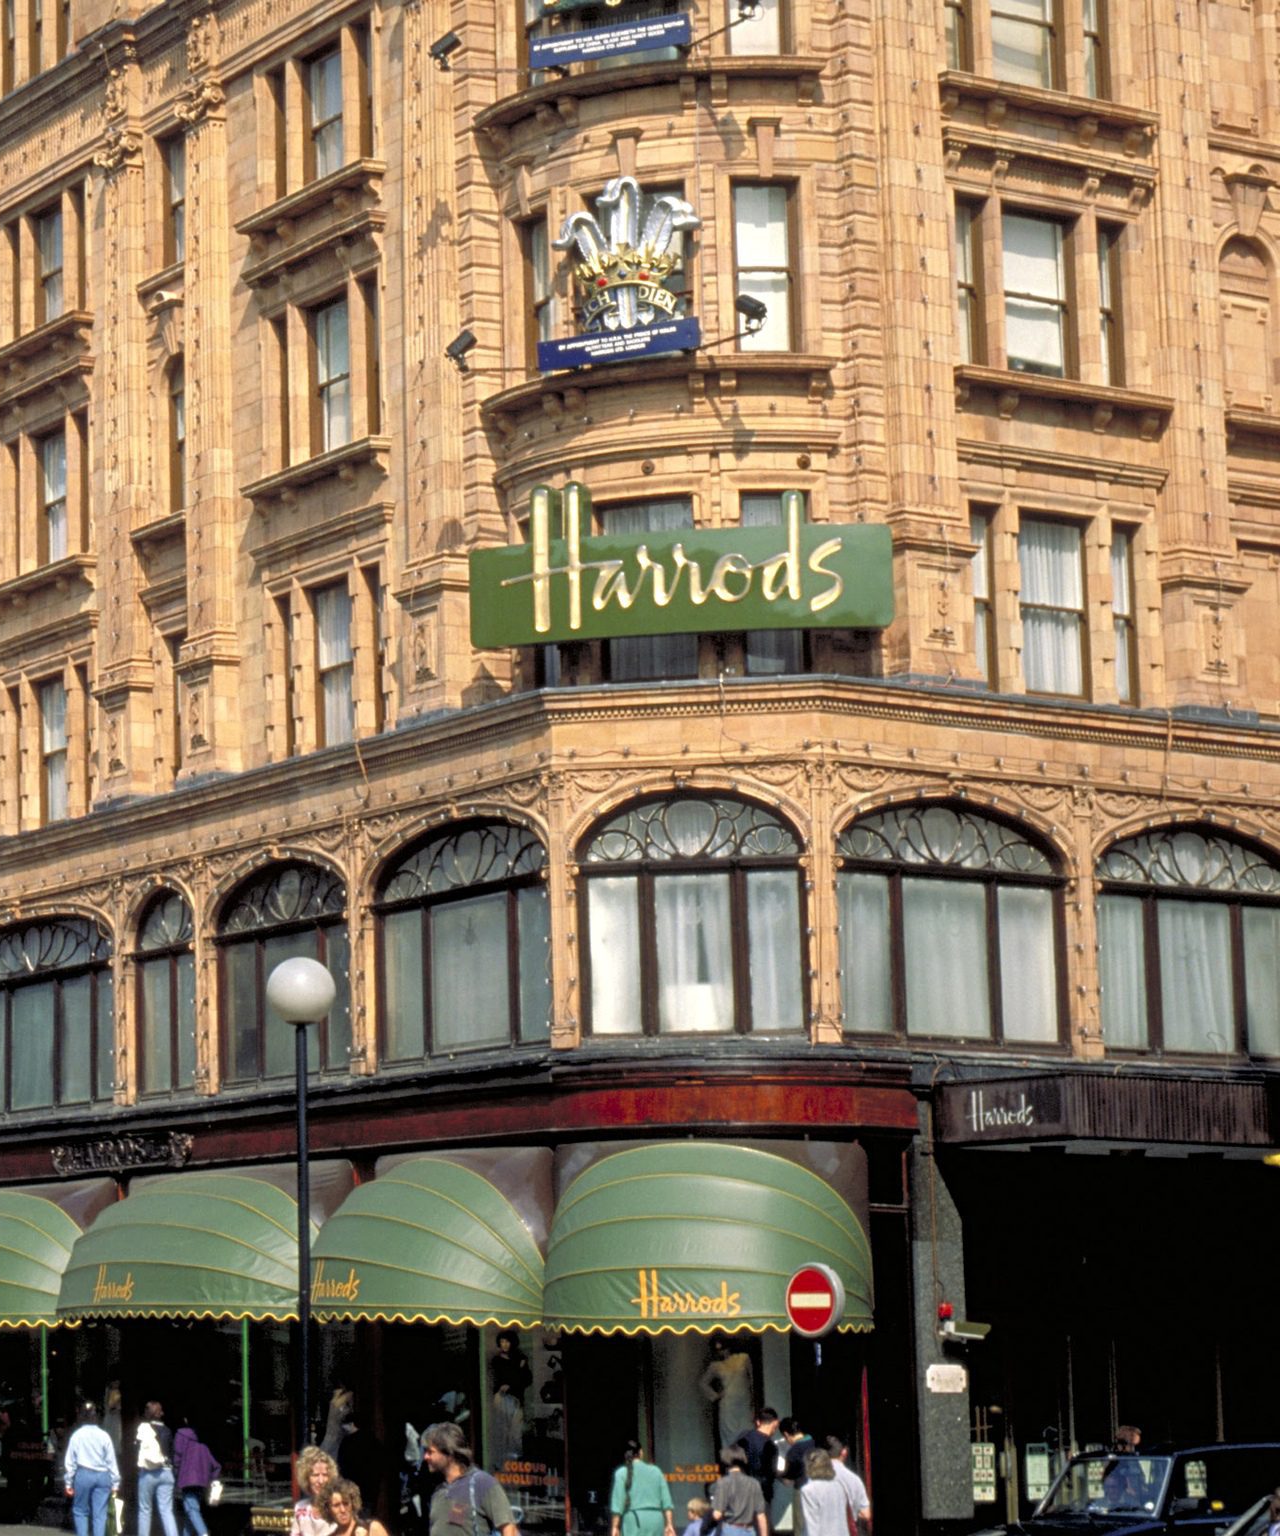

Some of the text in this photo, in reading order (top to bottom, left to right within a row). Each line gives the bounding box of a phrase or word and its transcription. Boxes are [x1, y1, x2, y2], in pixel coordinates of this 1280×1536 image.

[583, 285, 677, 318] ICH DIEN
[500, 484, 844, 633] Harrods
[965, 1089, 1034, 1132] Harrods
[92, 1263, 135, 1304] Harrods
[310, 1259, 361, 1303] Harrods
[631, 1269, 741, 1319] Harrods
[504, 1460, 546, 1472] COLOUR
